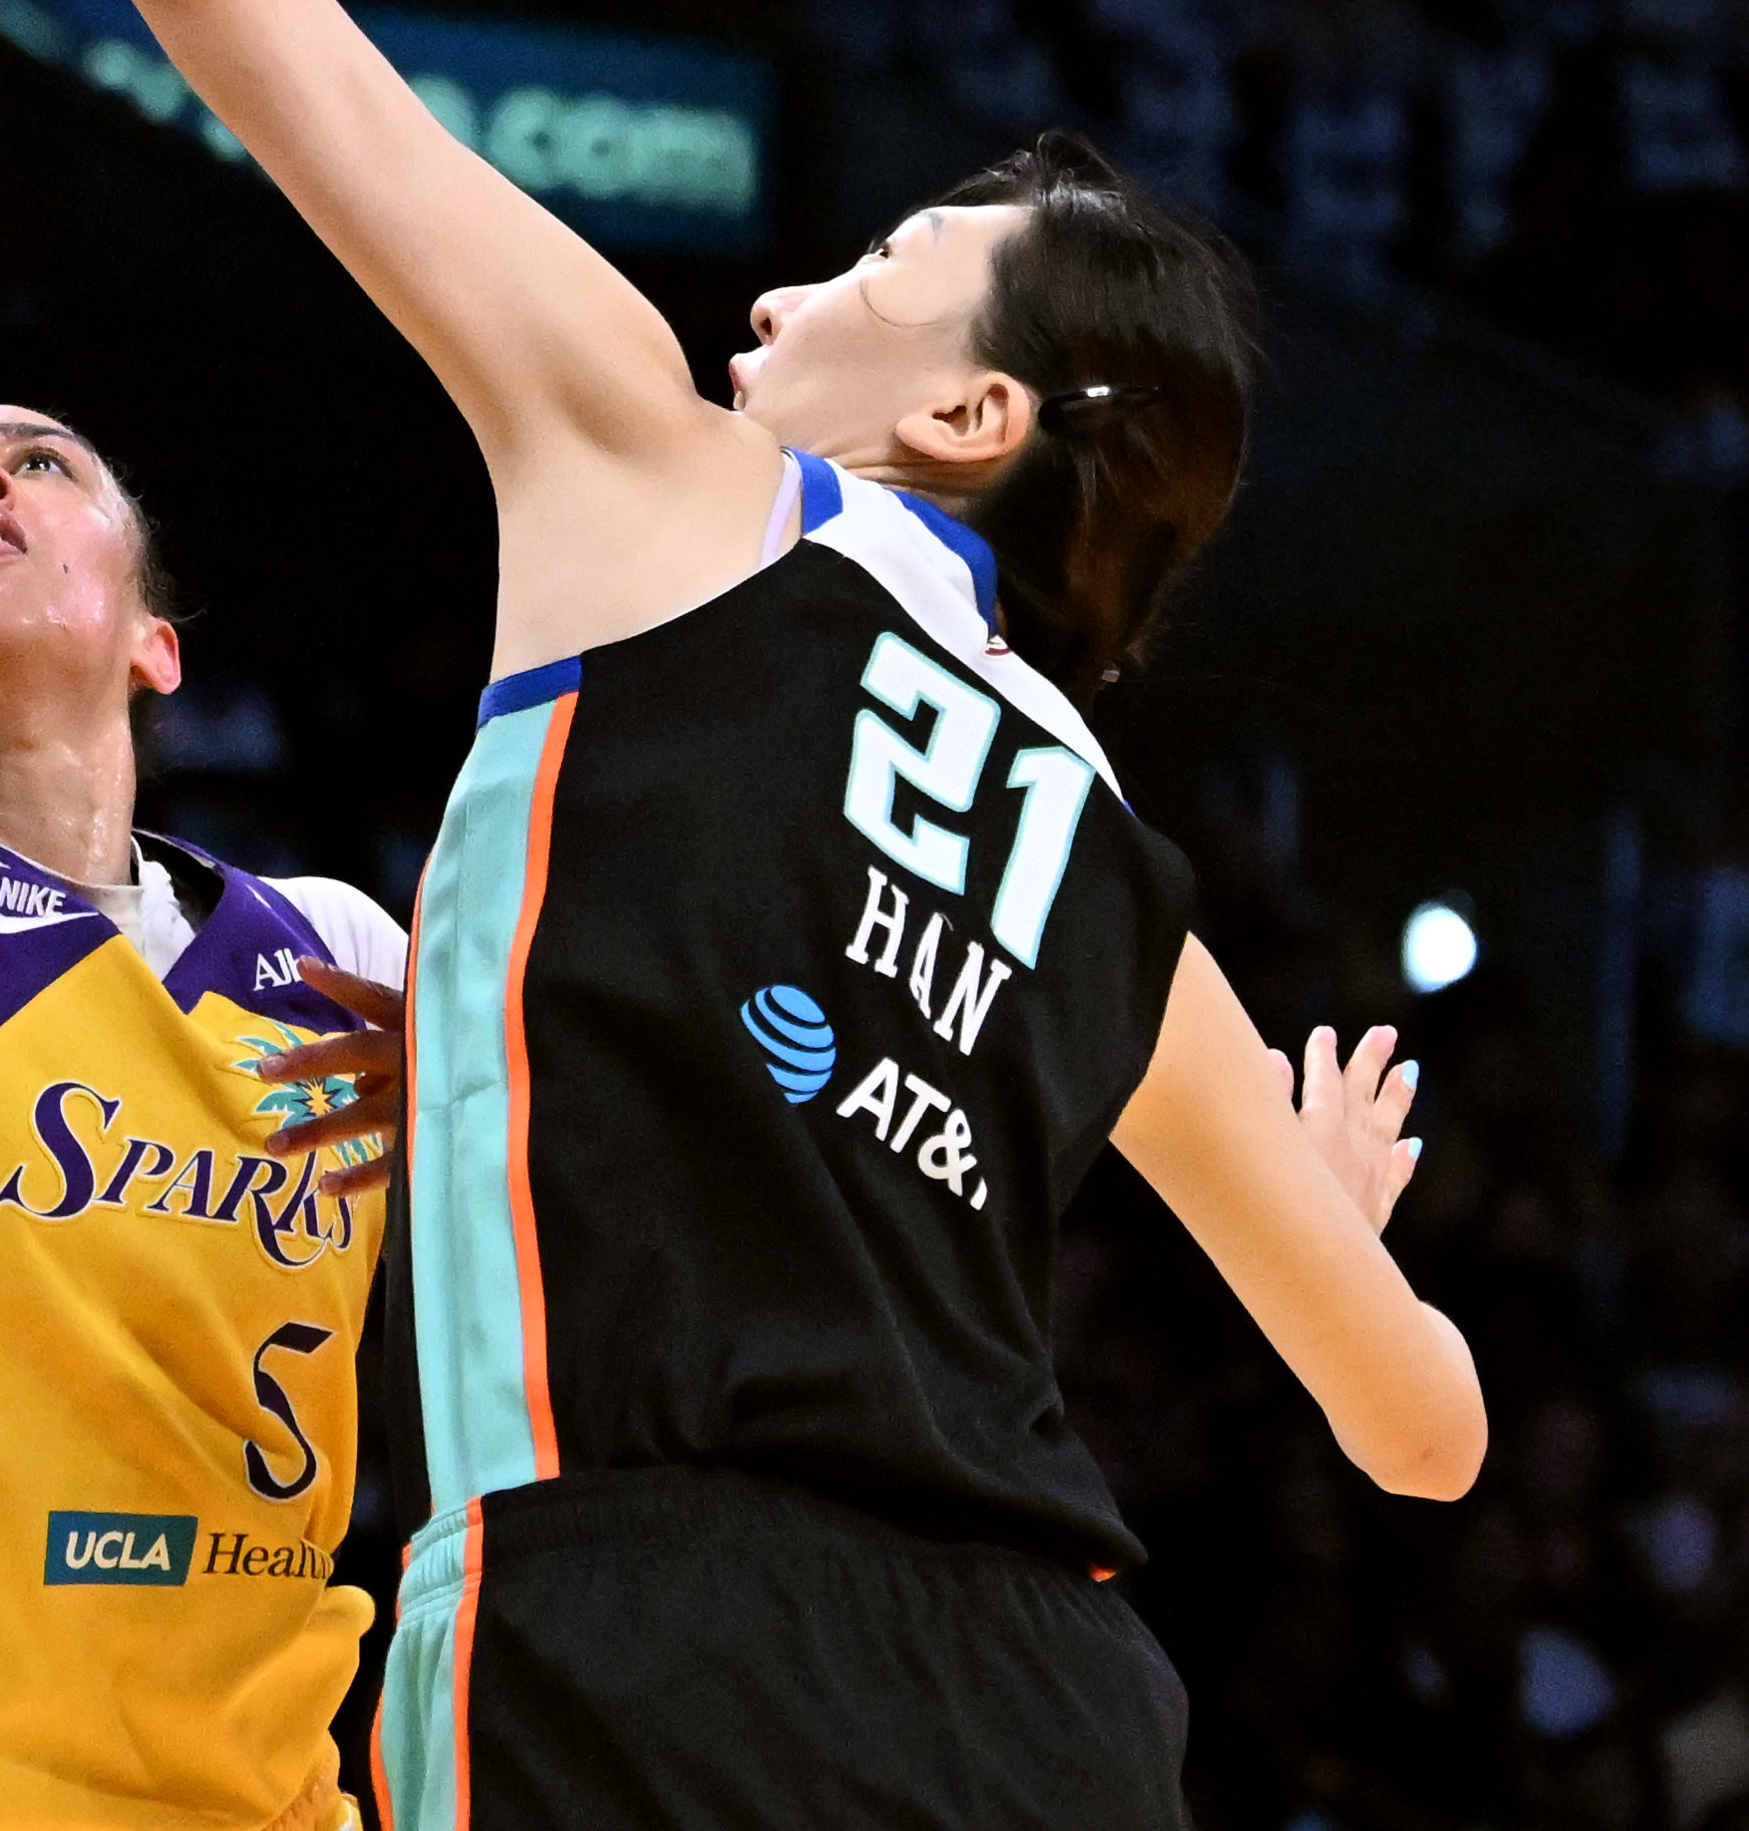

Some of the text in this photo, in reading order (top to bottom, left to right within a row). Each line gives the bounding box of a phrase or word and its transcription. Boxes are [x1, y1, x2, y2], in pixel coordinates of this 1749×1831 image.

[843, 631, 1096, 970] 21
[845, 865, 1013, 1057] HAN
[243, 1320, 336, 1503] 5
[64, 1529, 171, 1572] UCLA
